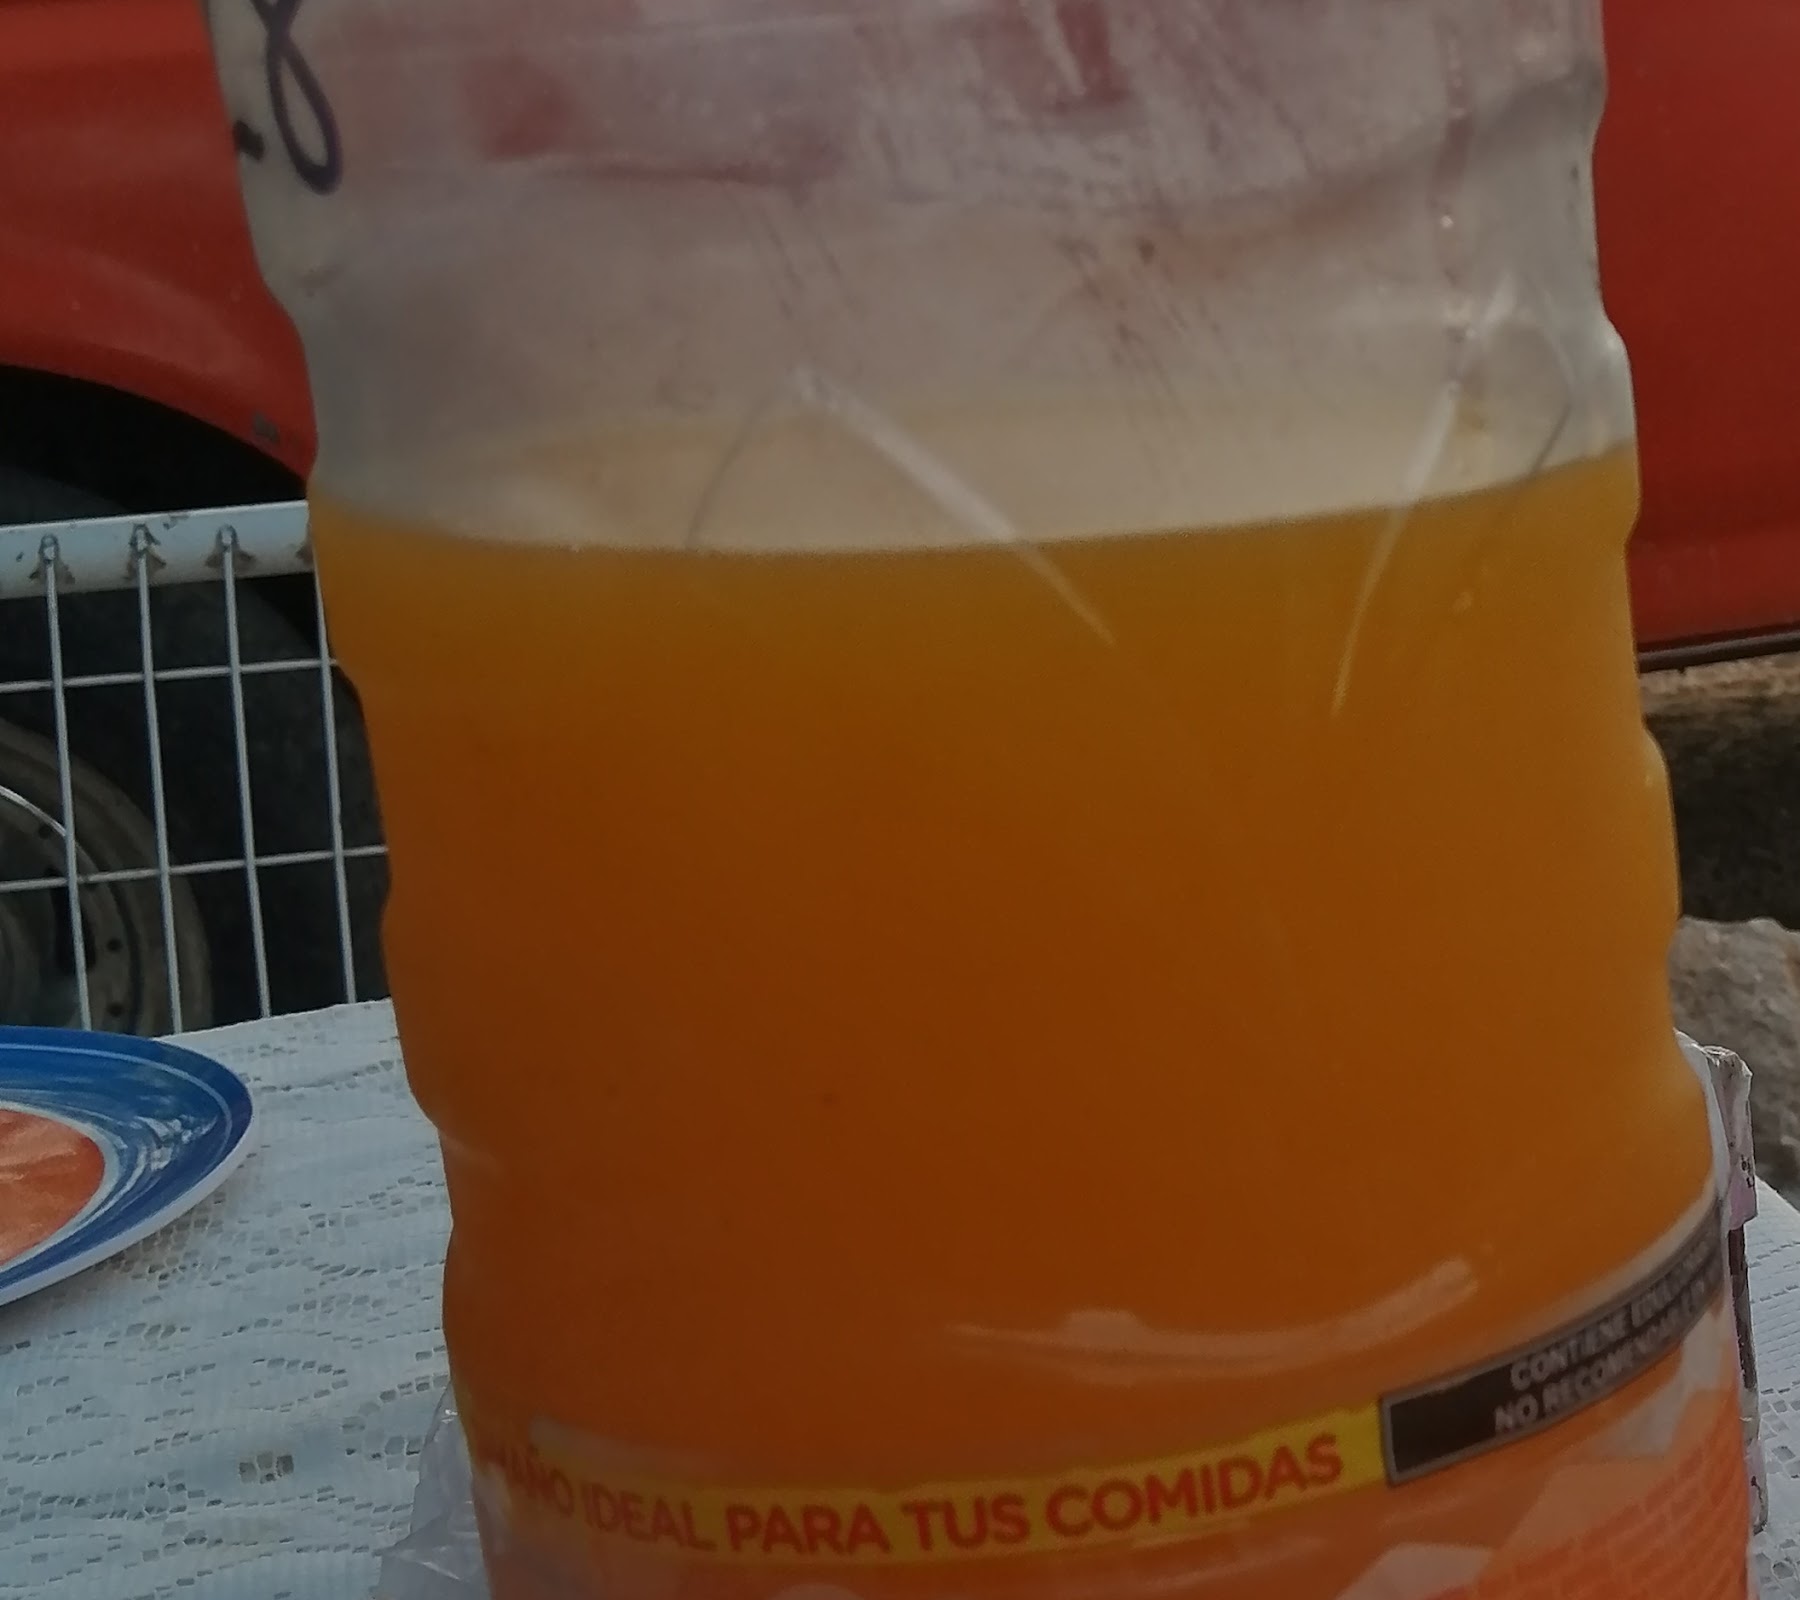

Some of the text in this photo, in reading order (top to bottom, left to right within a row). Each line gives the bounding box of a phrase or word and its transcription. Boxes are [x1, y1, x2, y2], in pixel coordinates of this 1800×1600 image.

[1495, 1392, 1538, 1434] NO
[583, 1483, 718, 1553] IDEAL
[724, 1503, 892, 1554] PARA
[904, 1493, 1031, 1552] TUS
[1045, 1432, 1345, 1538] COMIDAS
